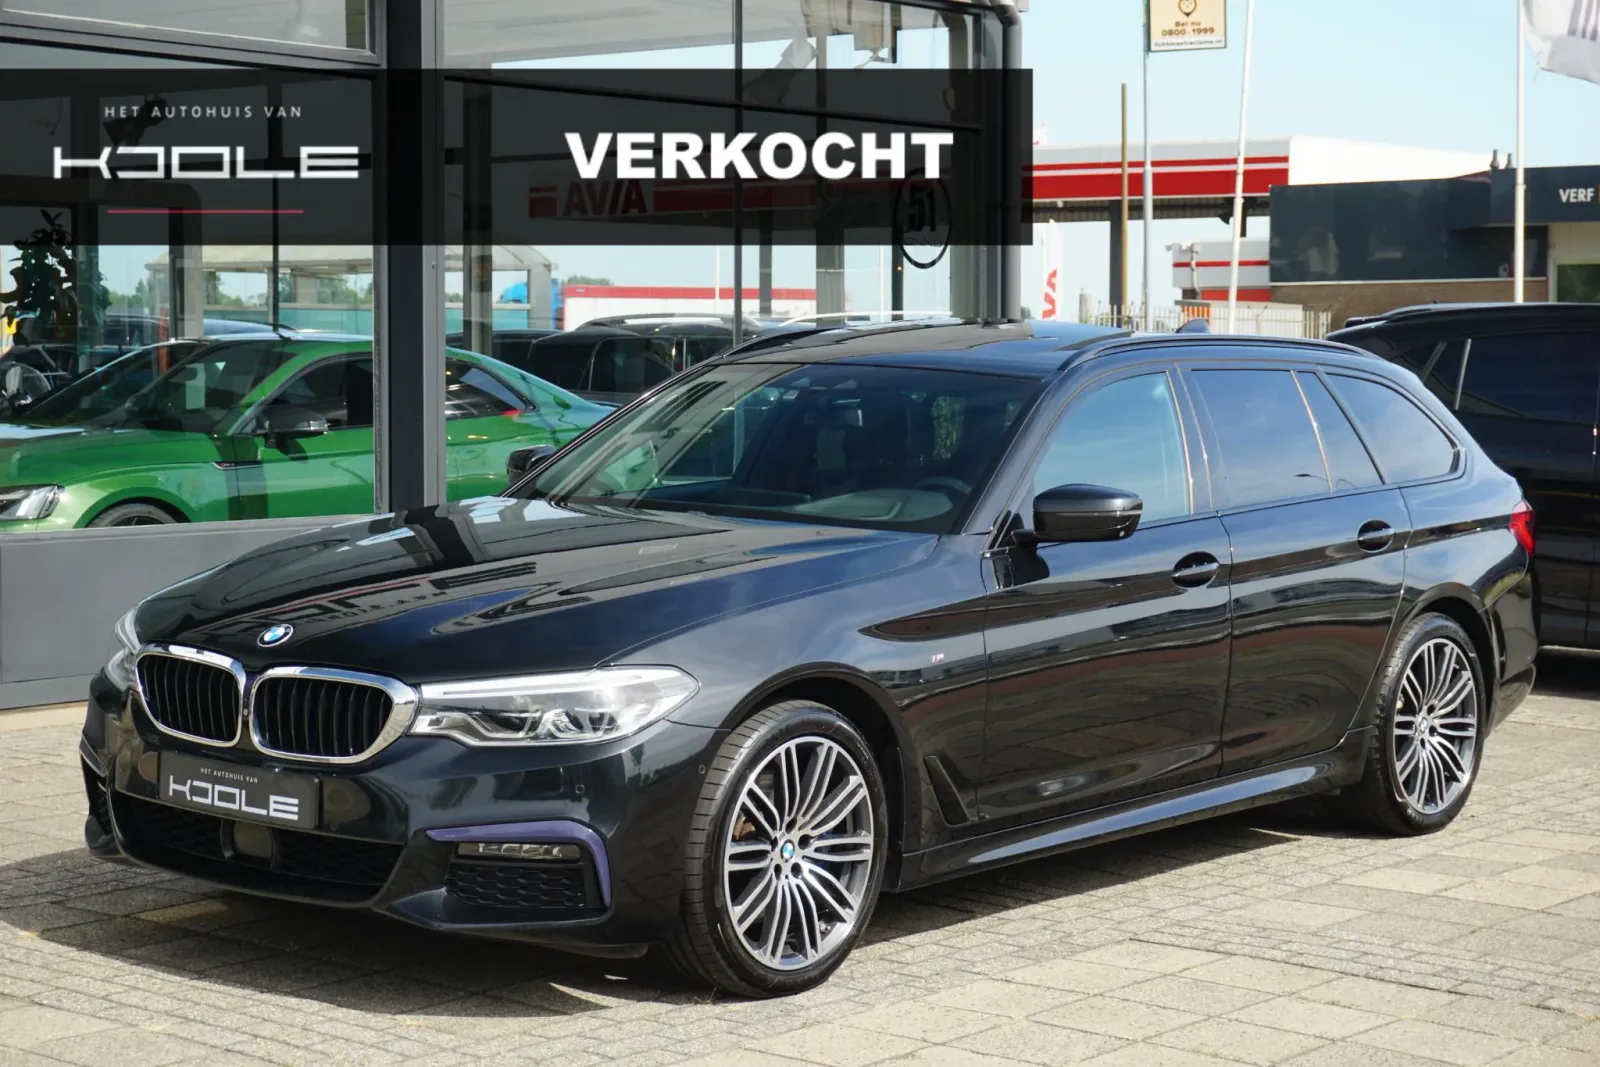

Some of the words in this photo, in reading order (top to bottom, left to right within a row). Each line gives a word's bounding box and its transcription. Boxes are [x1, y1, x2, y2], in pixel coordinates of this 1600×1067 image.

[562, 180, 648, 217] AVIA
[1558, 188, 1595, 203] VERF
[200, 767, 211, 775] HET
[214, 770, 244, 781] AUTOHUIS
[246, 776, 258, 784] VAN
